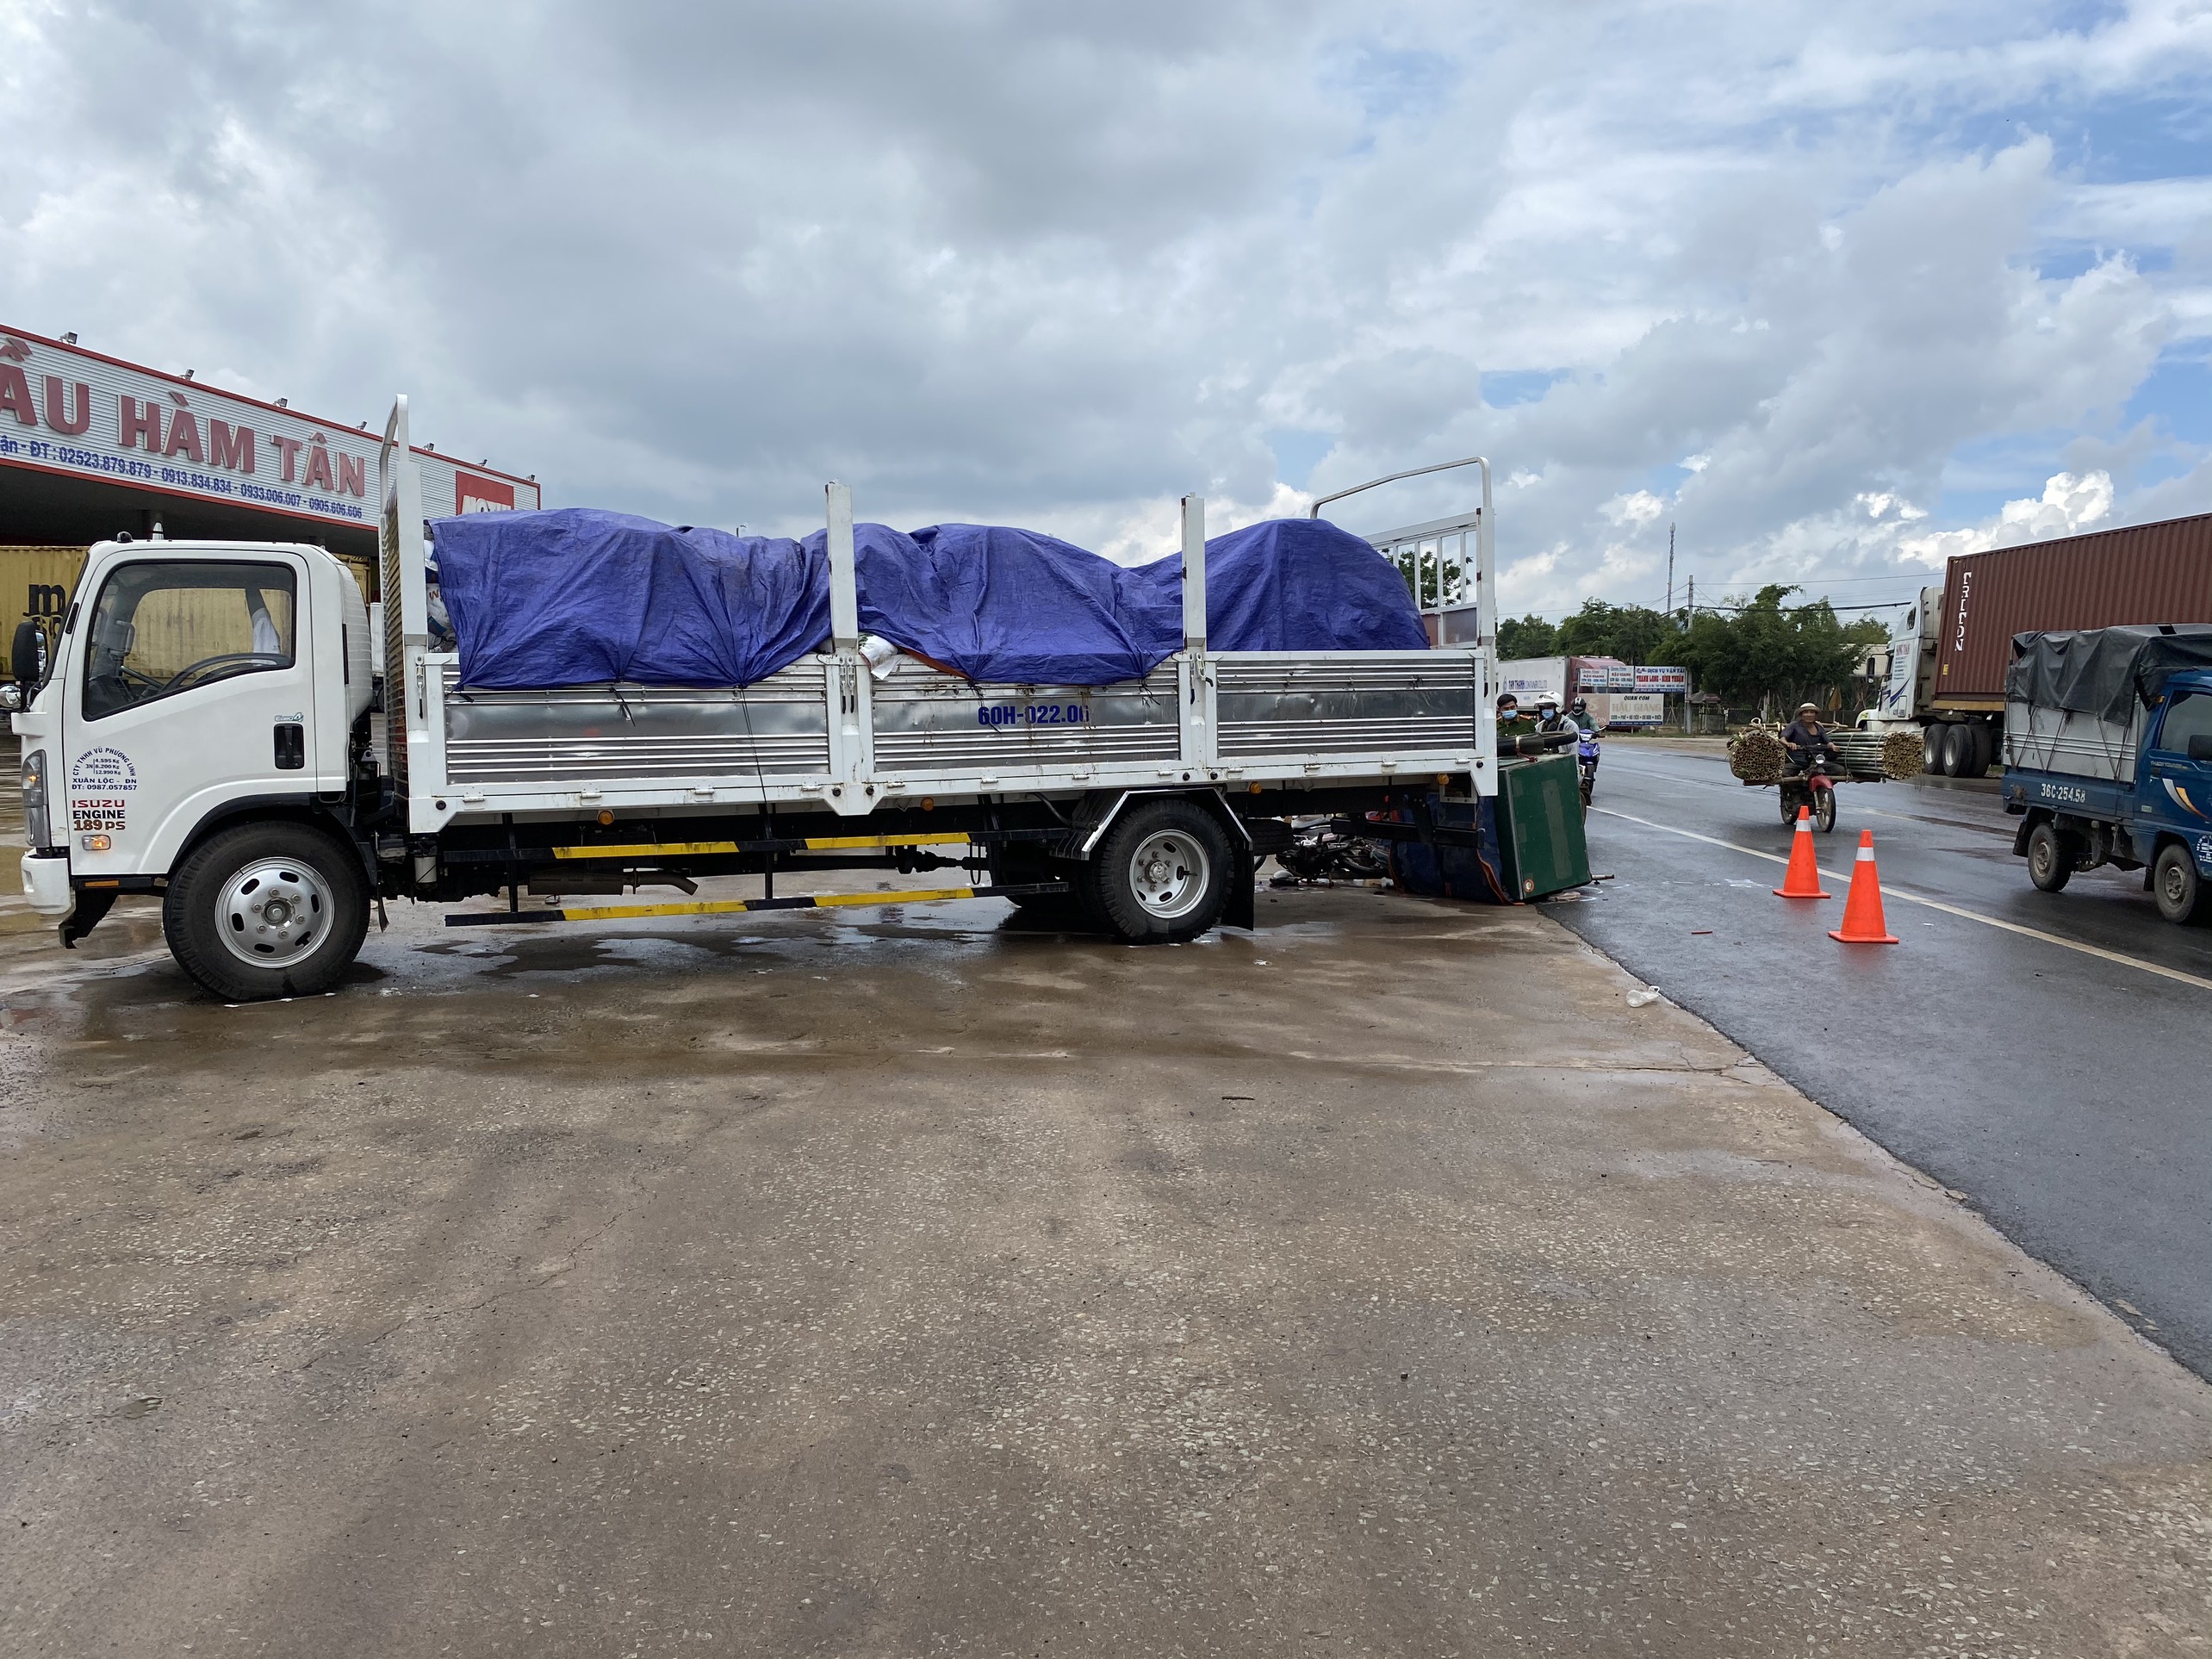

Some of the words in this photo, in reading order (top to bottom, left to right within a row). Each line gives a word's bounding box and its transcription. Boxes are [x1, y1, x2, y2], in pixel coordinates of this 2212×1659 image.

[0, 337, 90, 435] ẦU
[117, 391, 256, 473] HÀM
[270, 432, 364, 497] TÂN
[59, 446, 152, 478] 02523.879.879
[161, 467, 232, 494] 0913.834.834
[240, 483, 301, 506] 0933.006.007
[309, 497, 363, 519] 0905.606.606
[1954, 571, 1973, 651] TRITON
[1634, 703, 1662, 712] GIANG
[77, 750, 93, 764] TNHH
[127, 762, 136, 776] LINH
[72, 799, 125, 808] ISUZU
[73, 810, 126, 819] ENGINE
[74, 819, 103, 831] 189
[105, 821, 126, 830] PS
